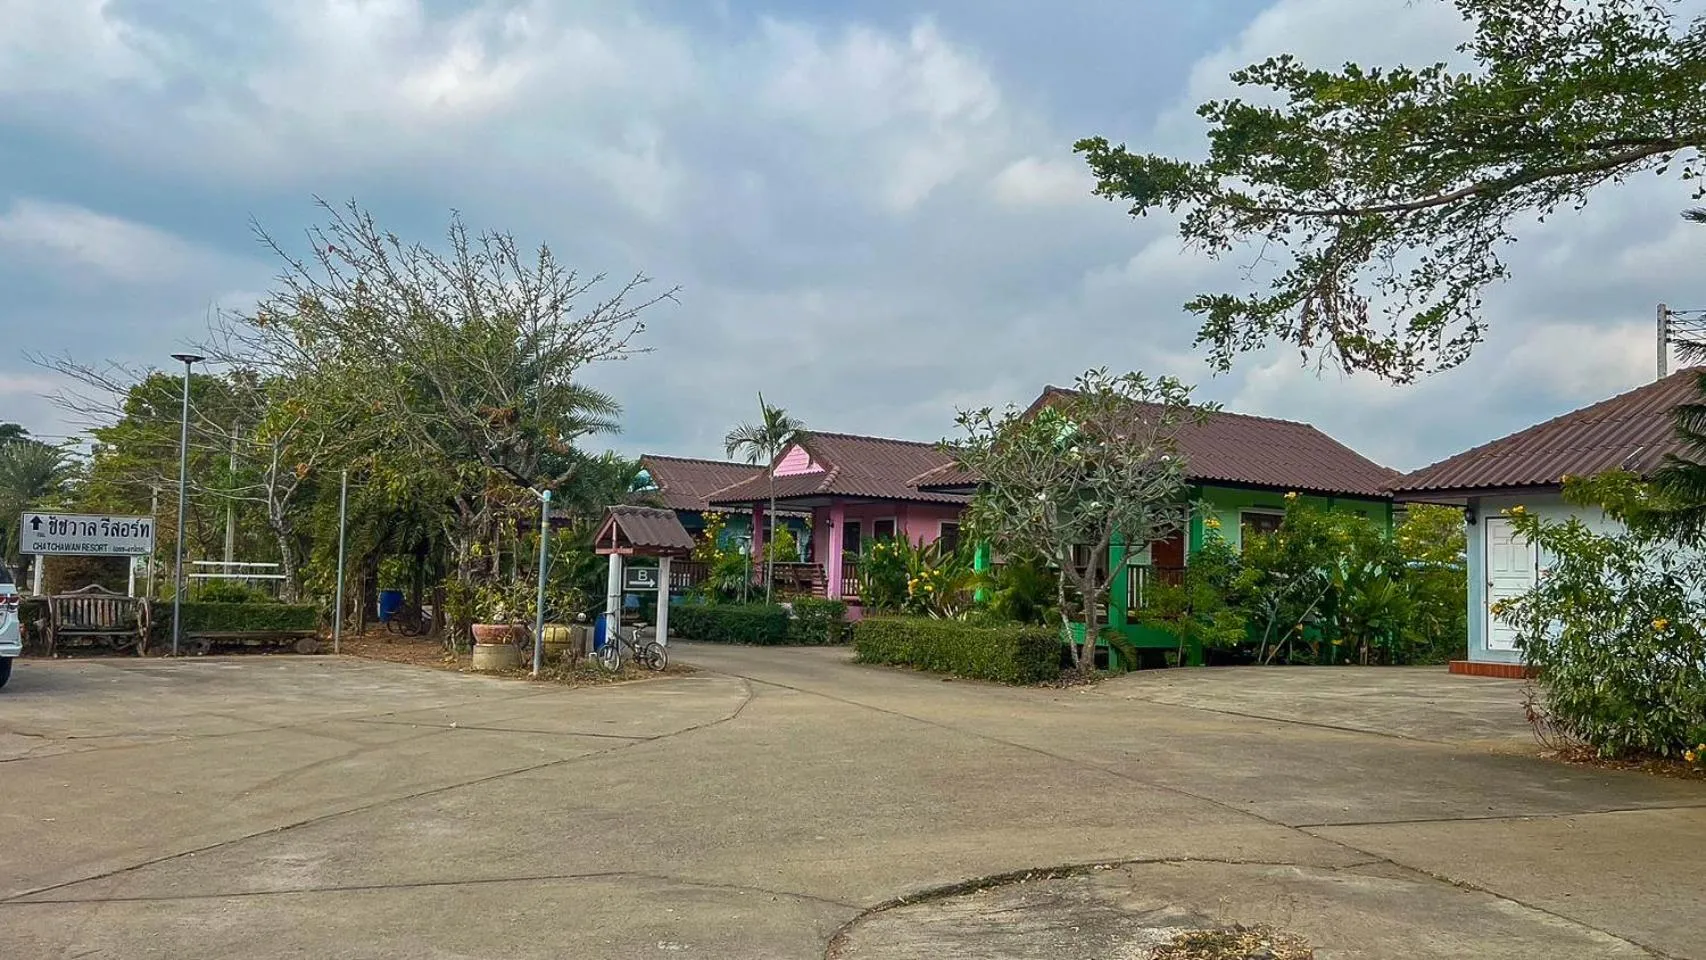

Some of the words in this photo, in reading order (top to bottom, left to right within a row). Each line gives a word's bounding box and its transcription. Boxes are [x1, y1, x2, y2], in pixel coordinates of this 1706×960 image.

[101, 518, 150, 538] รีสอร์ท
[32, 542, 81, 552] CHATCHAWAN
[82, 543, 109, 552] RESORT
[638, 570, 648, 581] B
